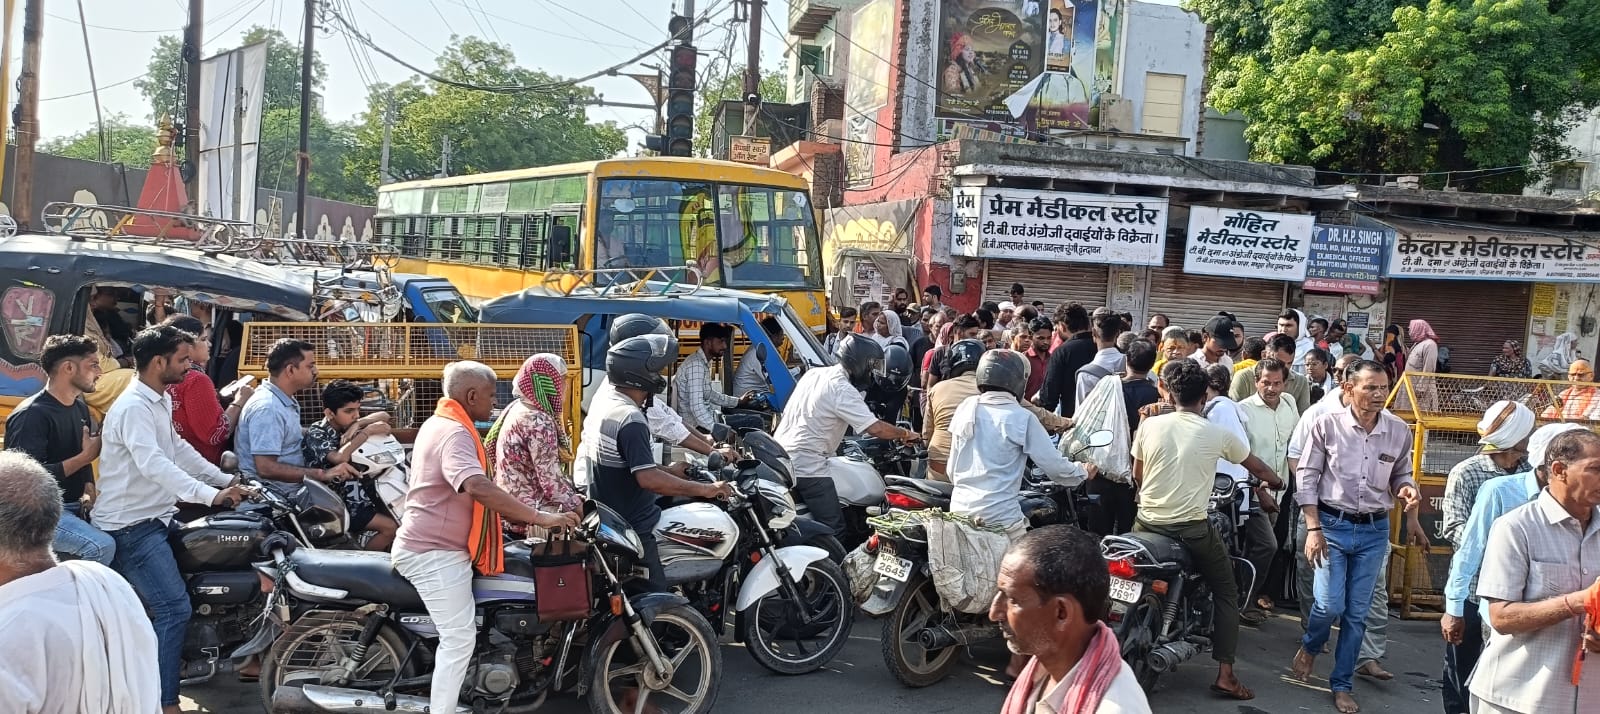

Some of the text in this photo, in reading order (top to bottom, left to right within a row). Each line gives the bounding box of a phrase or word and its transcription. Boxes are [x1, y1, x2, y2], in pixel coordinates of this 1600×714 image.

[957, 190, 975, 209] प्रेम
[989, 193, 1161, 225] प्रेम मेडीकल स्टोर
[1011, 223, 1027, 237] एवं
[1026, 224, 1063, 239] अंग्रेजी
[1105, 227, 1116, 241] के
[1223, 212, 1280, 234] मोहित
[956, 231, 974, 247] स्टोर
[1197, 228, 1301, 252] मेडीकल स्टोर
[1328, 228, 1383, 247] DR. H.P. SINGH
[1398, 235, 1458, 257] केदार
[1459, 236, 1539, 259] मेडीकल
[1540, 239, 1587, 261] स्टोर
[1348, 255, 1371, 263] OFFICER
[1427, 259, 1443, 267] दमा
[1509, 259, 1518, 268] के
[877, 562, 905, 578] 2645
